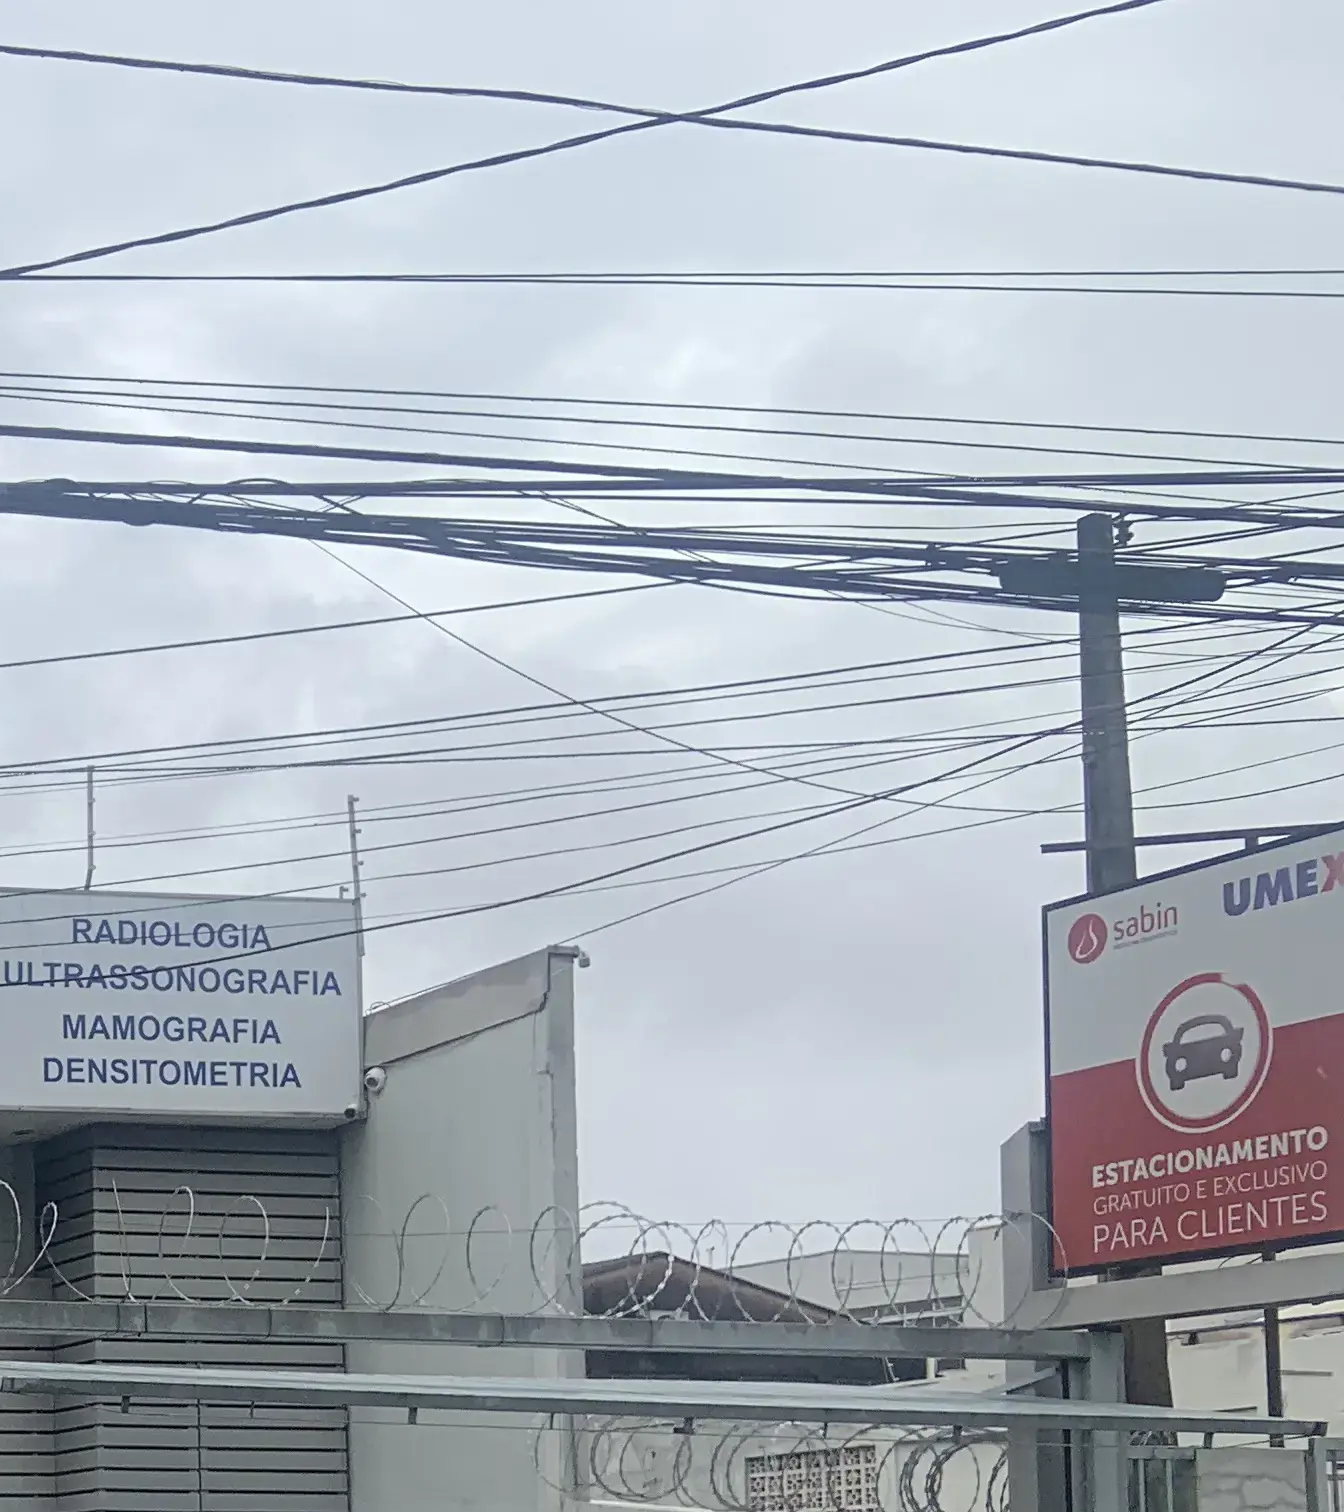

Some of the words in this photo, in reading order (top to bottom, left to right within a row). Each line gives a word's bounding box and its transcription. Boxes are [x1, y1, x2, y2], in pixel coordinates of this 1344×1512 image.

[1223, 851, 1344, 916] UMEX
[72, 918, 271, 950] RADIOLOGIA
[1113, 902, 1178, 941] sabin
[4, 961, 342, 996] ULTRASSONOGRAFIA
[62, 1014, 281, 1044] MAMOGRAFIA
[43, 1057, 302, 1088] DENSITOMETRIA
[1092, 1126, 1328, 1188] ESTACIONAMENTO
[1093, 1183, 1190, 1215] GRATUITO
[1196, 1180, 1207, 1200] E
[1214, 1160, 1327, 1196] EXCLUSIVO
[1094, 1215, 1169, 1253] PARA
[1177, 1190, 1327, 1240] CLIENTES
